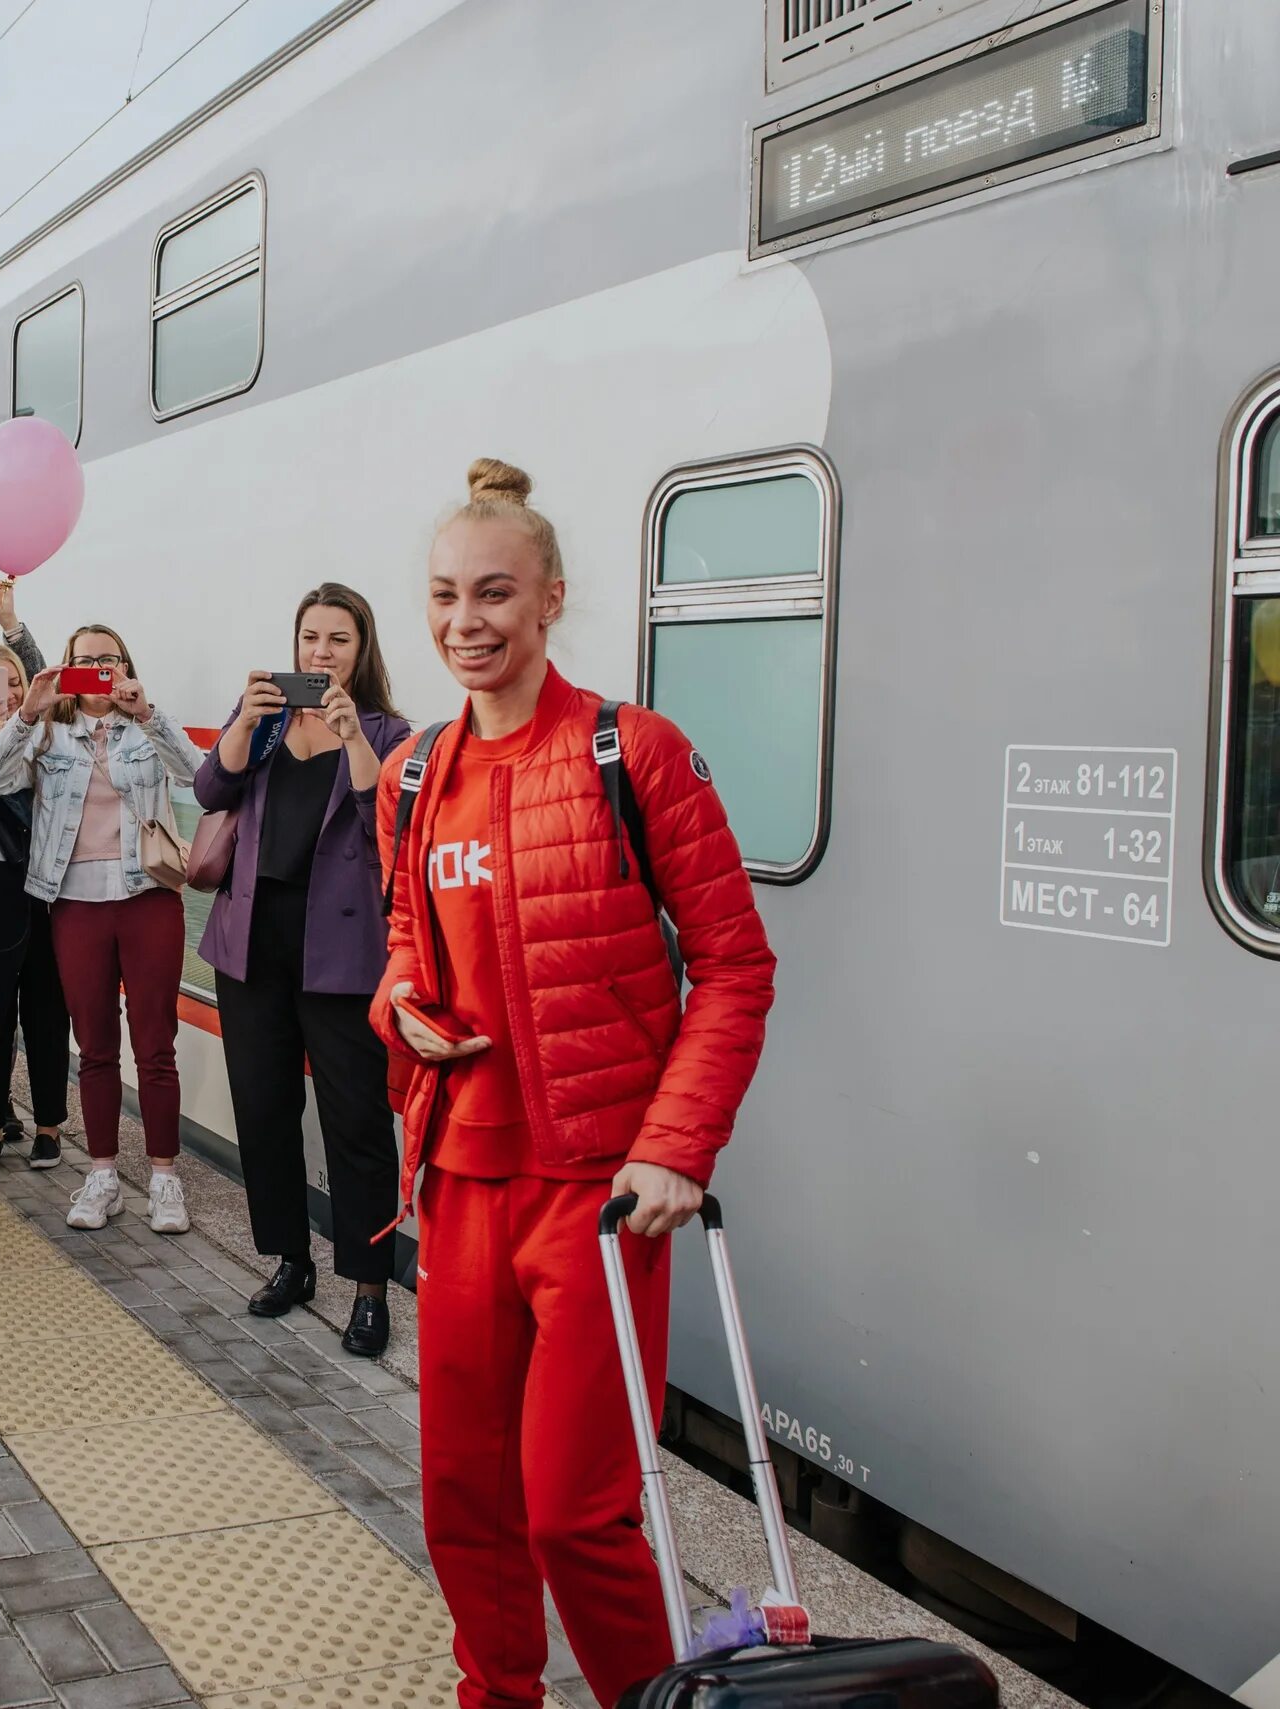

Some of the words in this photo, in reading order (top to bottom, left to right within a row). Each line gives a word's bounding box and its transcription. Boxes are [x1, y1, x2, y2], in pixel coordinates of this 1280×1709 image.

[905, 88, 1036, 162] поезд
[1016, 762, 1031, 793] 2
[1034, 779, 1070, 794] ЭТАЖ
[1076, 763, 1165, 799] 81-112
[1014, 821, 1025, 851] 1
[1027, 837, 1063, 854] ЭТАЖ
[1103, 827, 1162, 863] 1-32
[1011, 880, 1099, 920] МЕСТ
[1122, 892, 1160, 928] 64
[317, 1170, 330, 1192] 31
